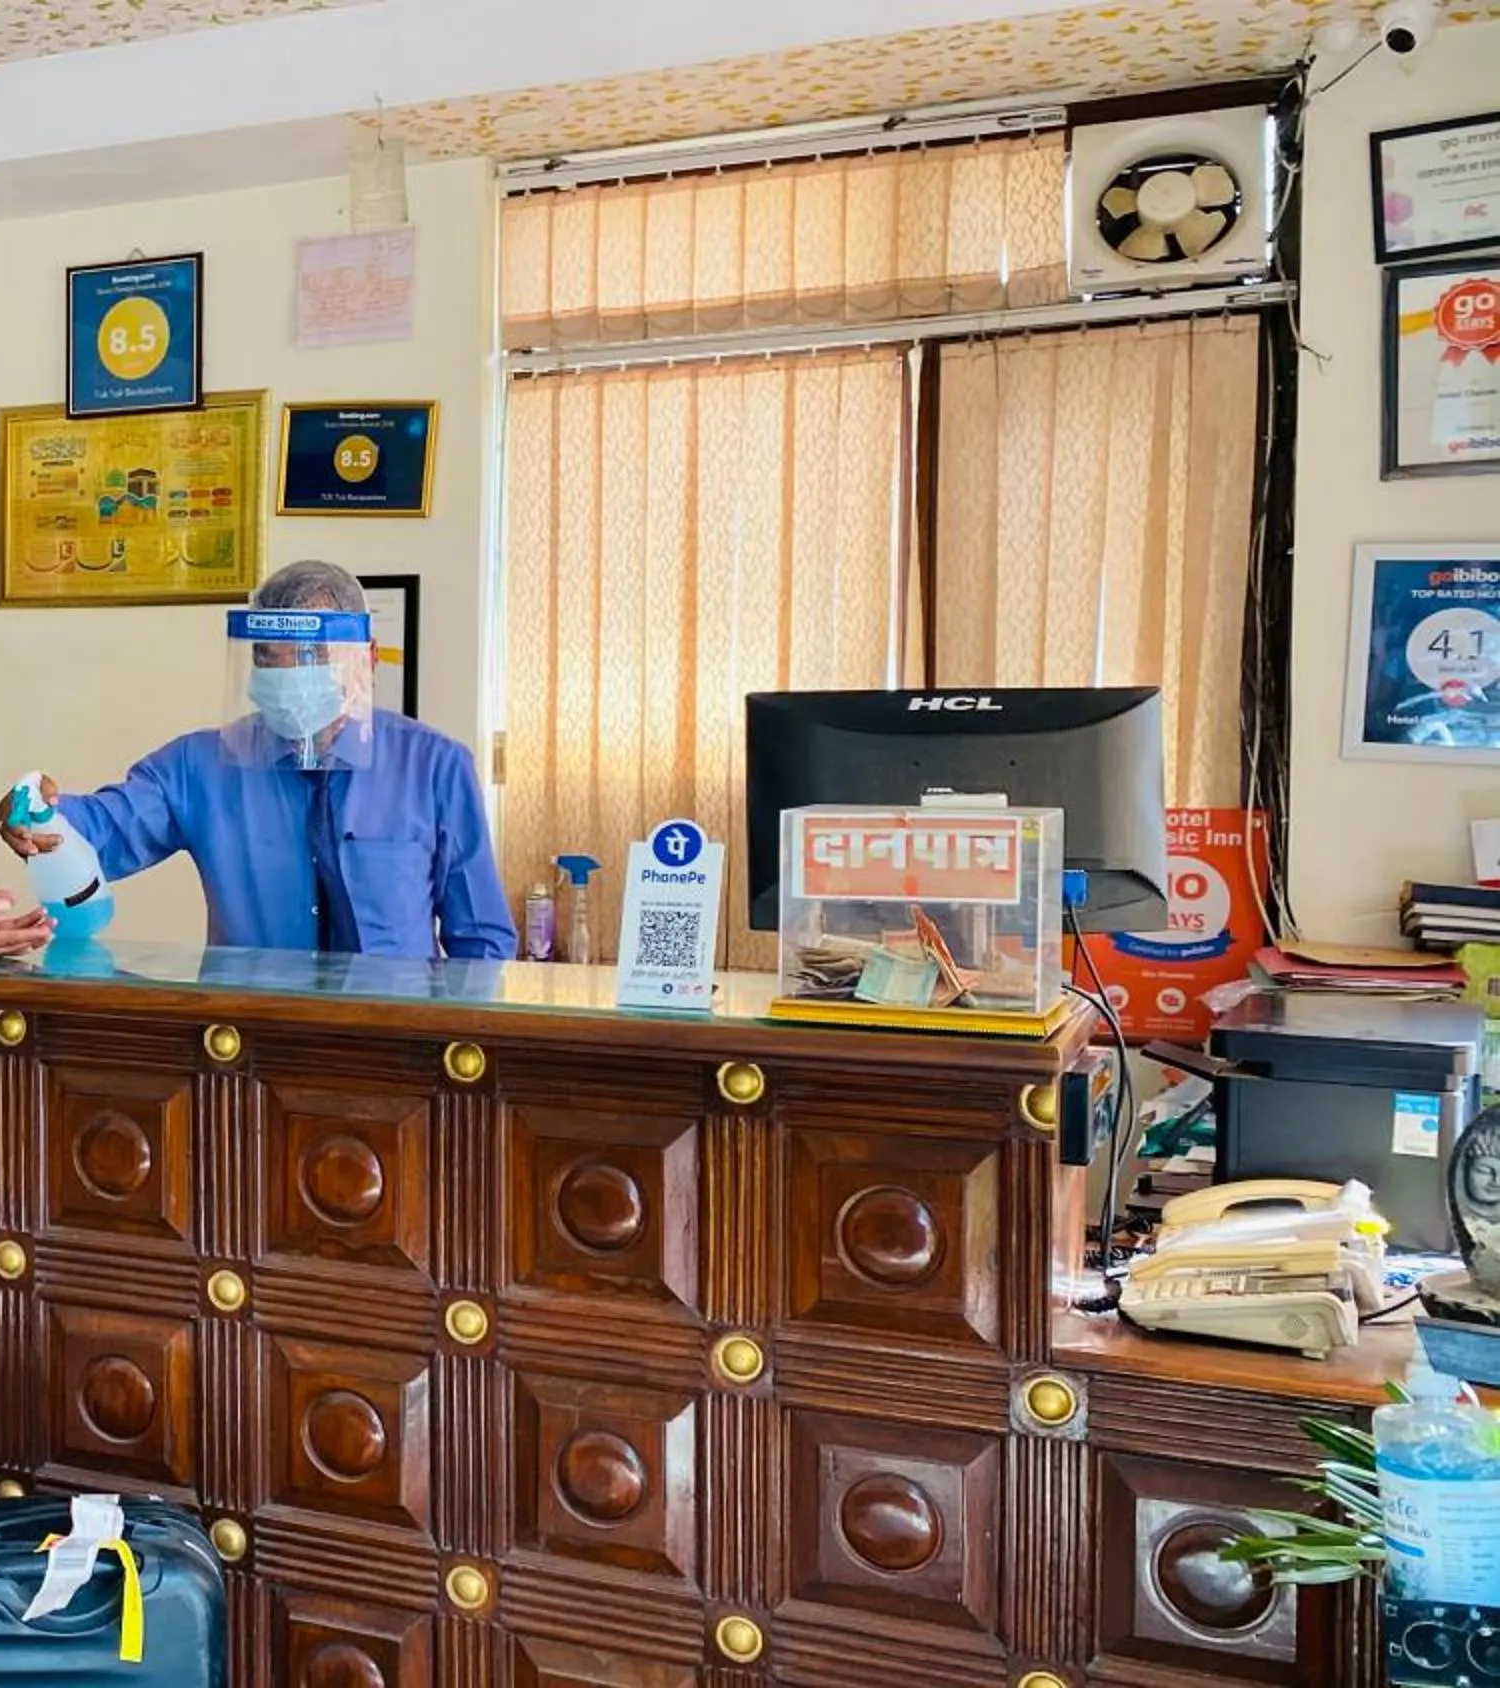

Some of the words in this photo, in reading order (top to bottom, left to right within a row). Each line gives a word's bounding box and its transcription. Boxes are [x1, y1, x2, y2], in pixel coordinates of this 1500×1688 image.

[1454, 293, 1495, 318] go
[110, 324, 157, 355] 8.5
[341, 450, 371, 467] 8.5
[1428, 568, 1499, 586] goibibo
[1411, 589, 1434, 599] TOP
[1428, 629, 1484, 660] 4.1
[908, 697, 1003, 711] HCL
[1166, 811, 1211, 827] otel
[1206, 829, 1242, 845] Inn
[809, 828, 1015, 871] दानपात्र
[641, 869, 706, 884] PhonePe
